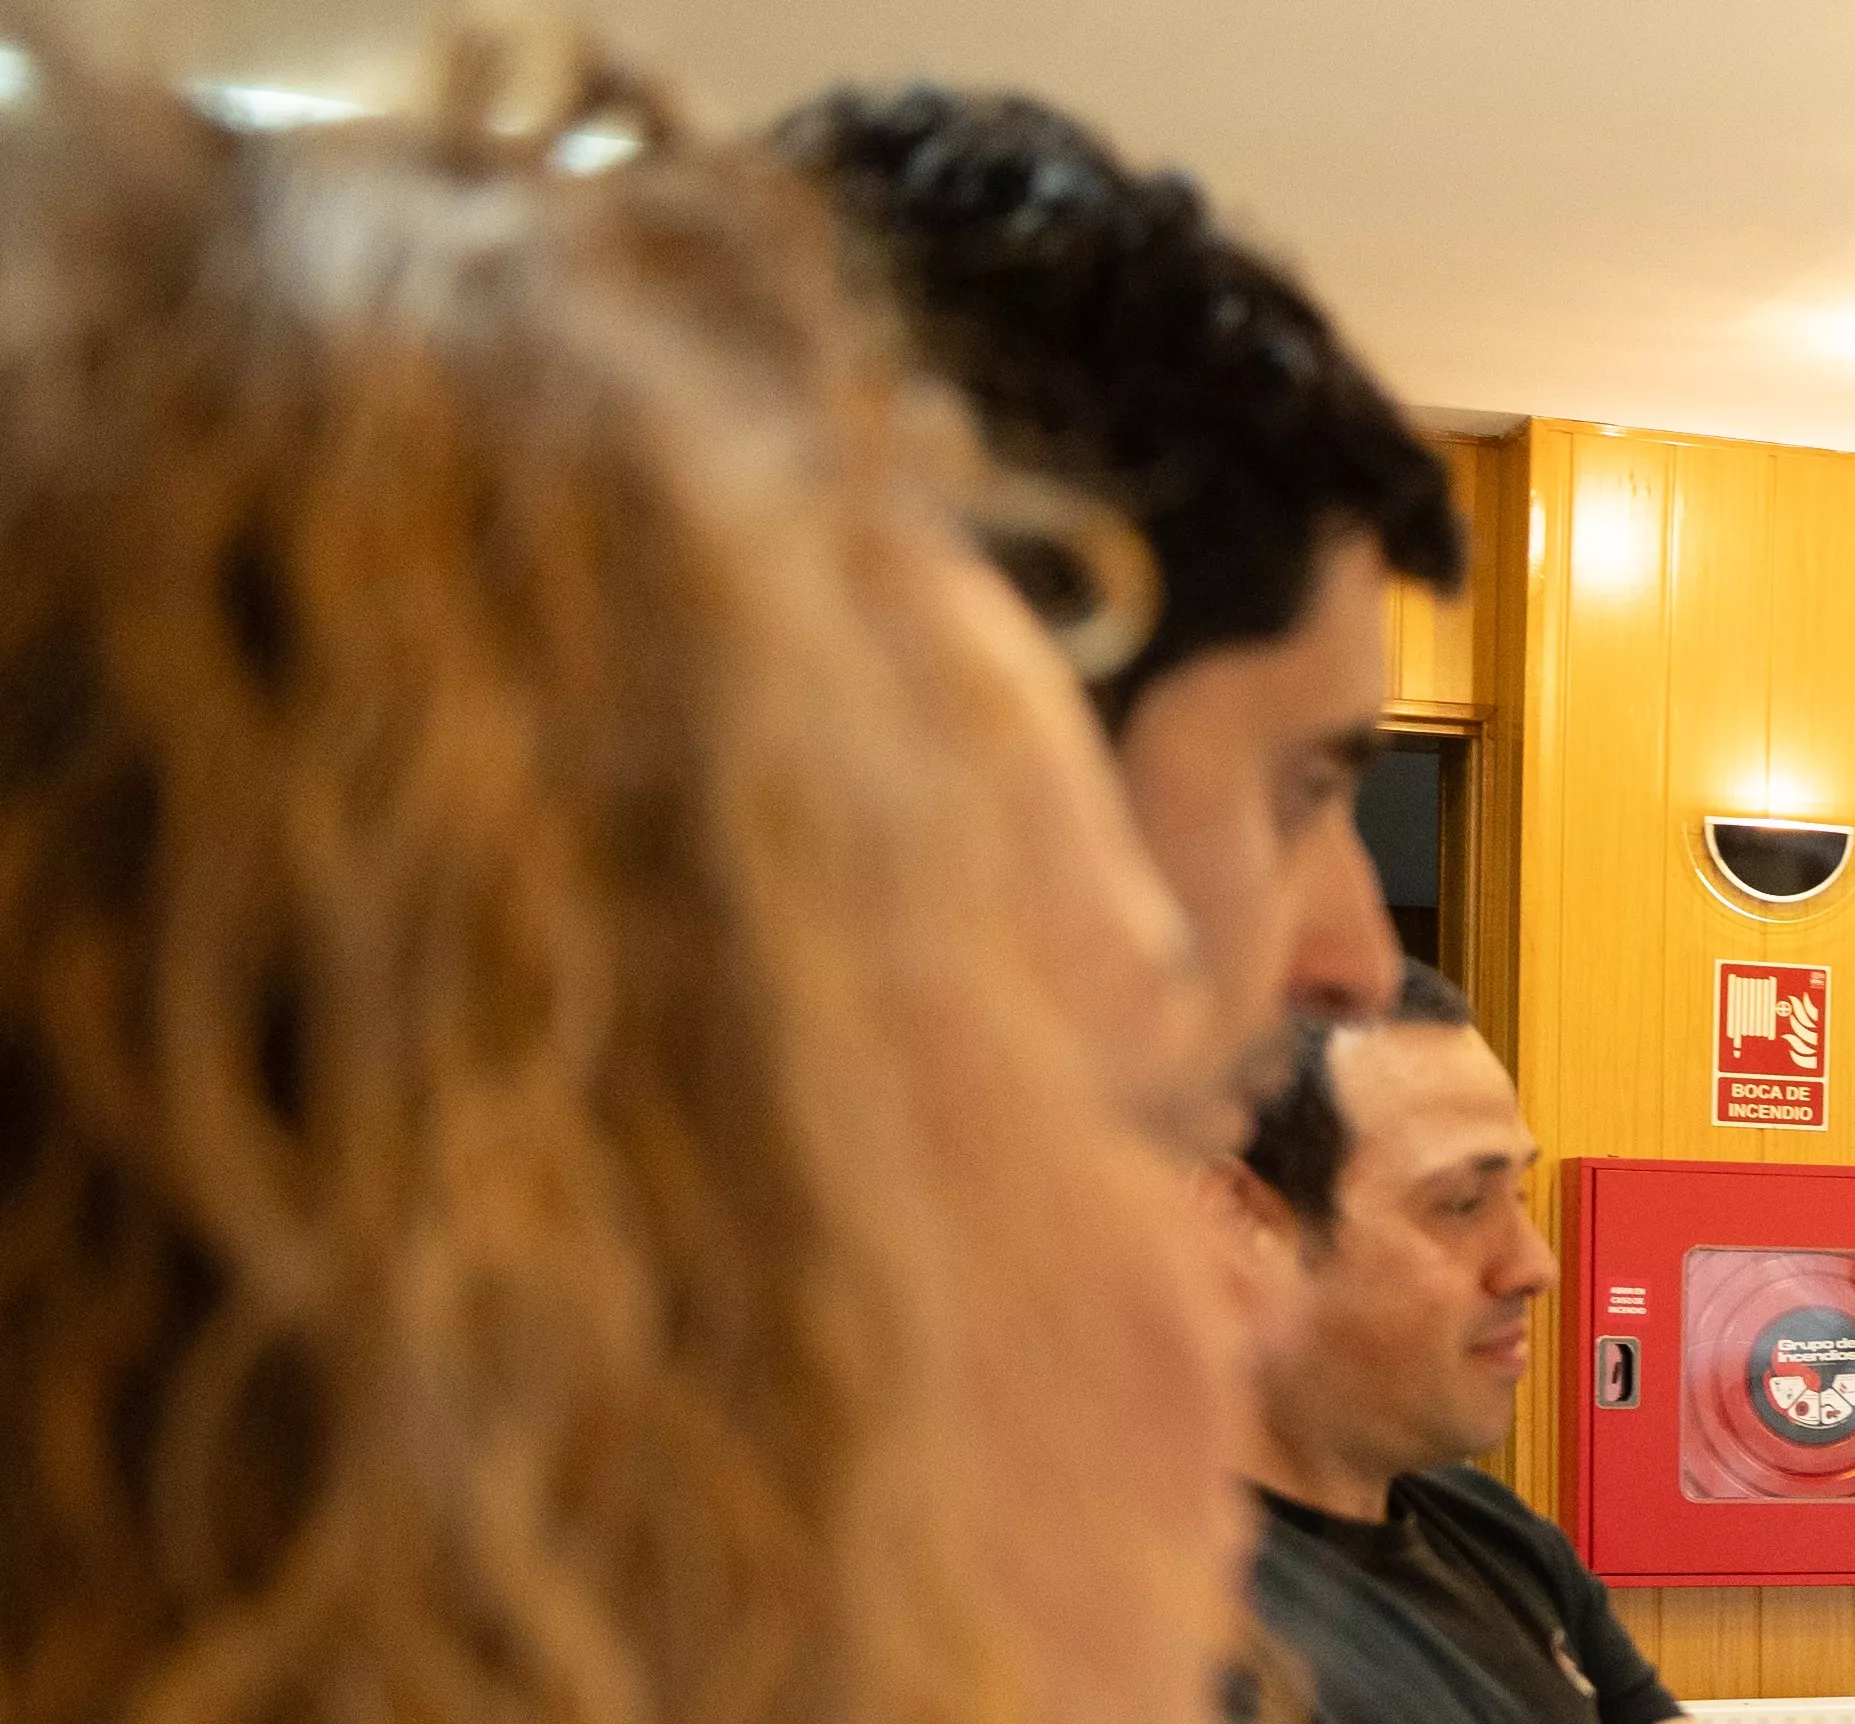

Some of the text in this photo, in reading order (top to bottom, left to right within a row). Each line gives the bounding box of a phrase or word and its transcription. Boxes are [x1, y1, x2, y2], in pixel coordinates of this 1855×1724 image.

[1731, 1083, 1811, 1101] BOCA DE
[1728, 1103, 1813, 1120] INCENDIO
[1778, 1340, 1834, 1351] Grupo
